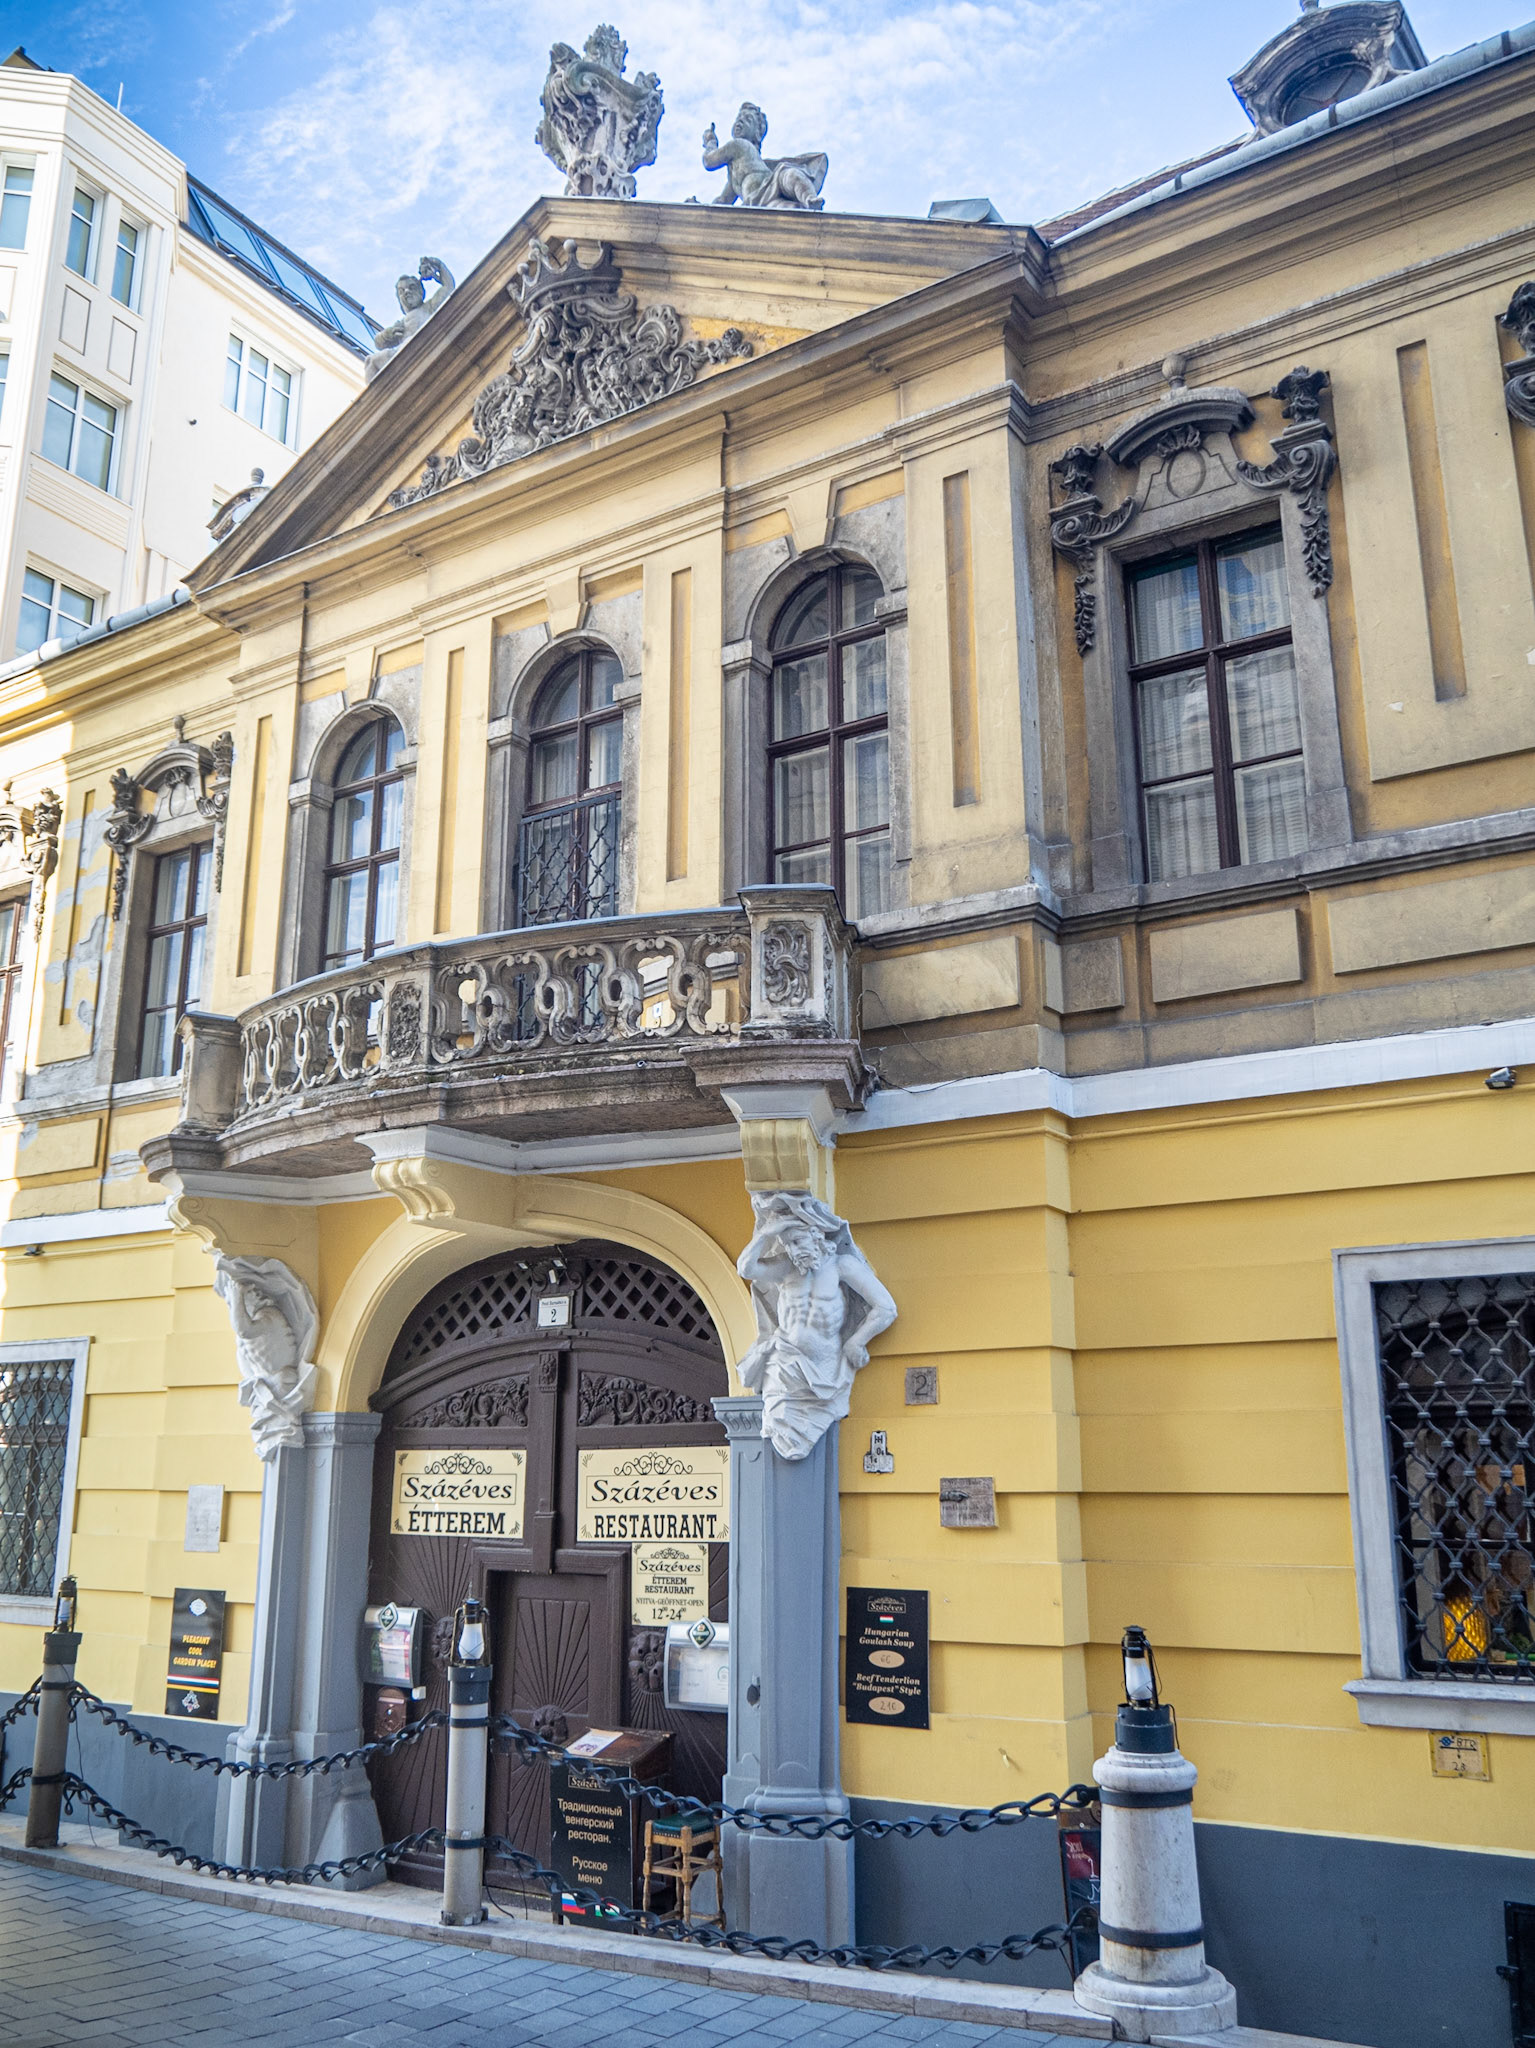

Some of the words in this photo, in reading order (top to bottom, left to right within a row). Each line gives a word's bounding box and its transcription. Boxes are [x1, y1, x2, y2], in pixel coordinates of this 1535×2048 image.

[551, 1308, 557, 1323] 2
[914, 1374, 928, 1396] 2
[404, 1476, 512, 1500] Százéves
[591, 1479, 717, 1503] Százéves
[408, 1505, 505, 1534] ÉTTEREM
[594, 1514, 717, 1539] RESTAURANT
[639, 1559, 701, 1573] Százéves
[652, 1575, 687, 1585] ÉTTEREM
[645, 1585, 694, 1595] RESTAURANT
[870, 1602, 903, 1612] Százéves
[864, 1627, 909, 1638] Hungarian
[182, 1635, 211, 1645] PLEASANT
[859, 1637, 892, 1646] Goulash
[893, 1638, 915, 1649] Soup
[188, 1646, 203, 1656] COOL
[173, 1656, 196, 1667] GARDEN
[197, 1658, 217, 1669] PLACE!
[856, 1673, 875, 1684] Beef
[899, 1686, 921, 1697] Style
[557, 1798, 622, 1816] Традиционный
[565, 1815, 614, 1830] венгерский
[568, 1829, 611, 1844] ресторан.
[572, 1856, 608, 1871] Русское
[578, 1873, 602, 1885] меню
